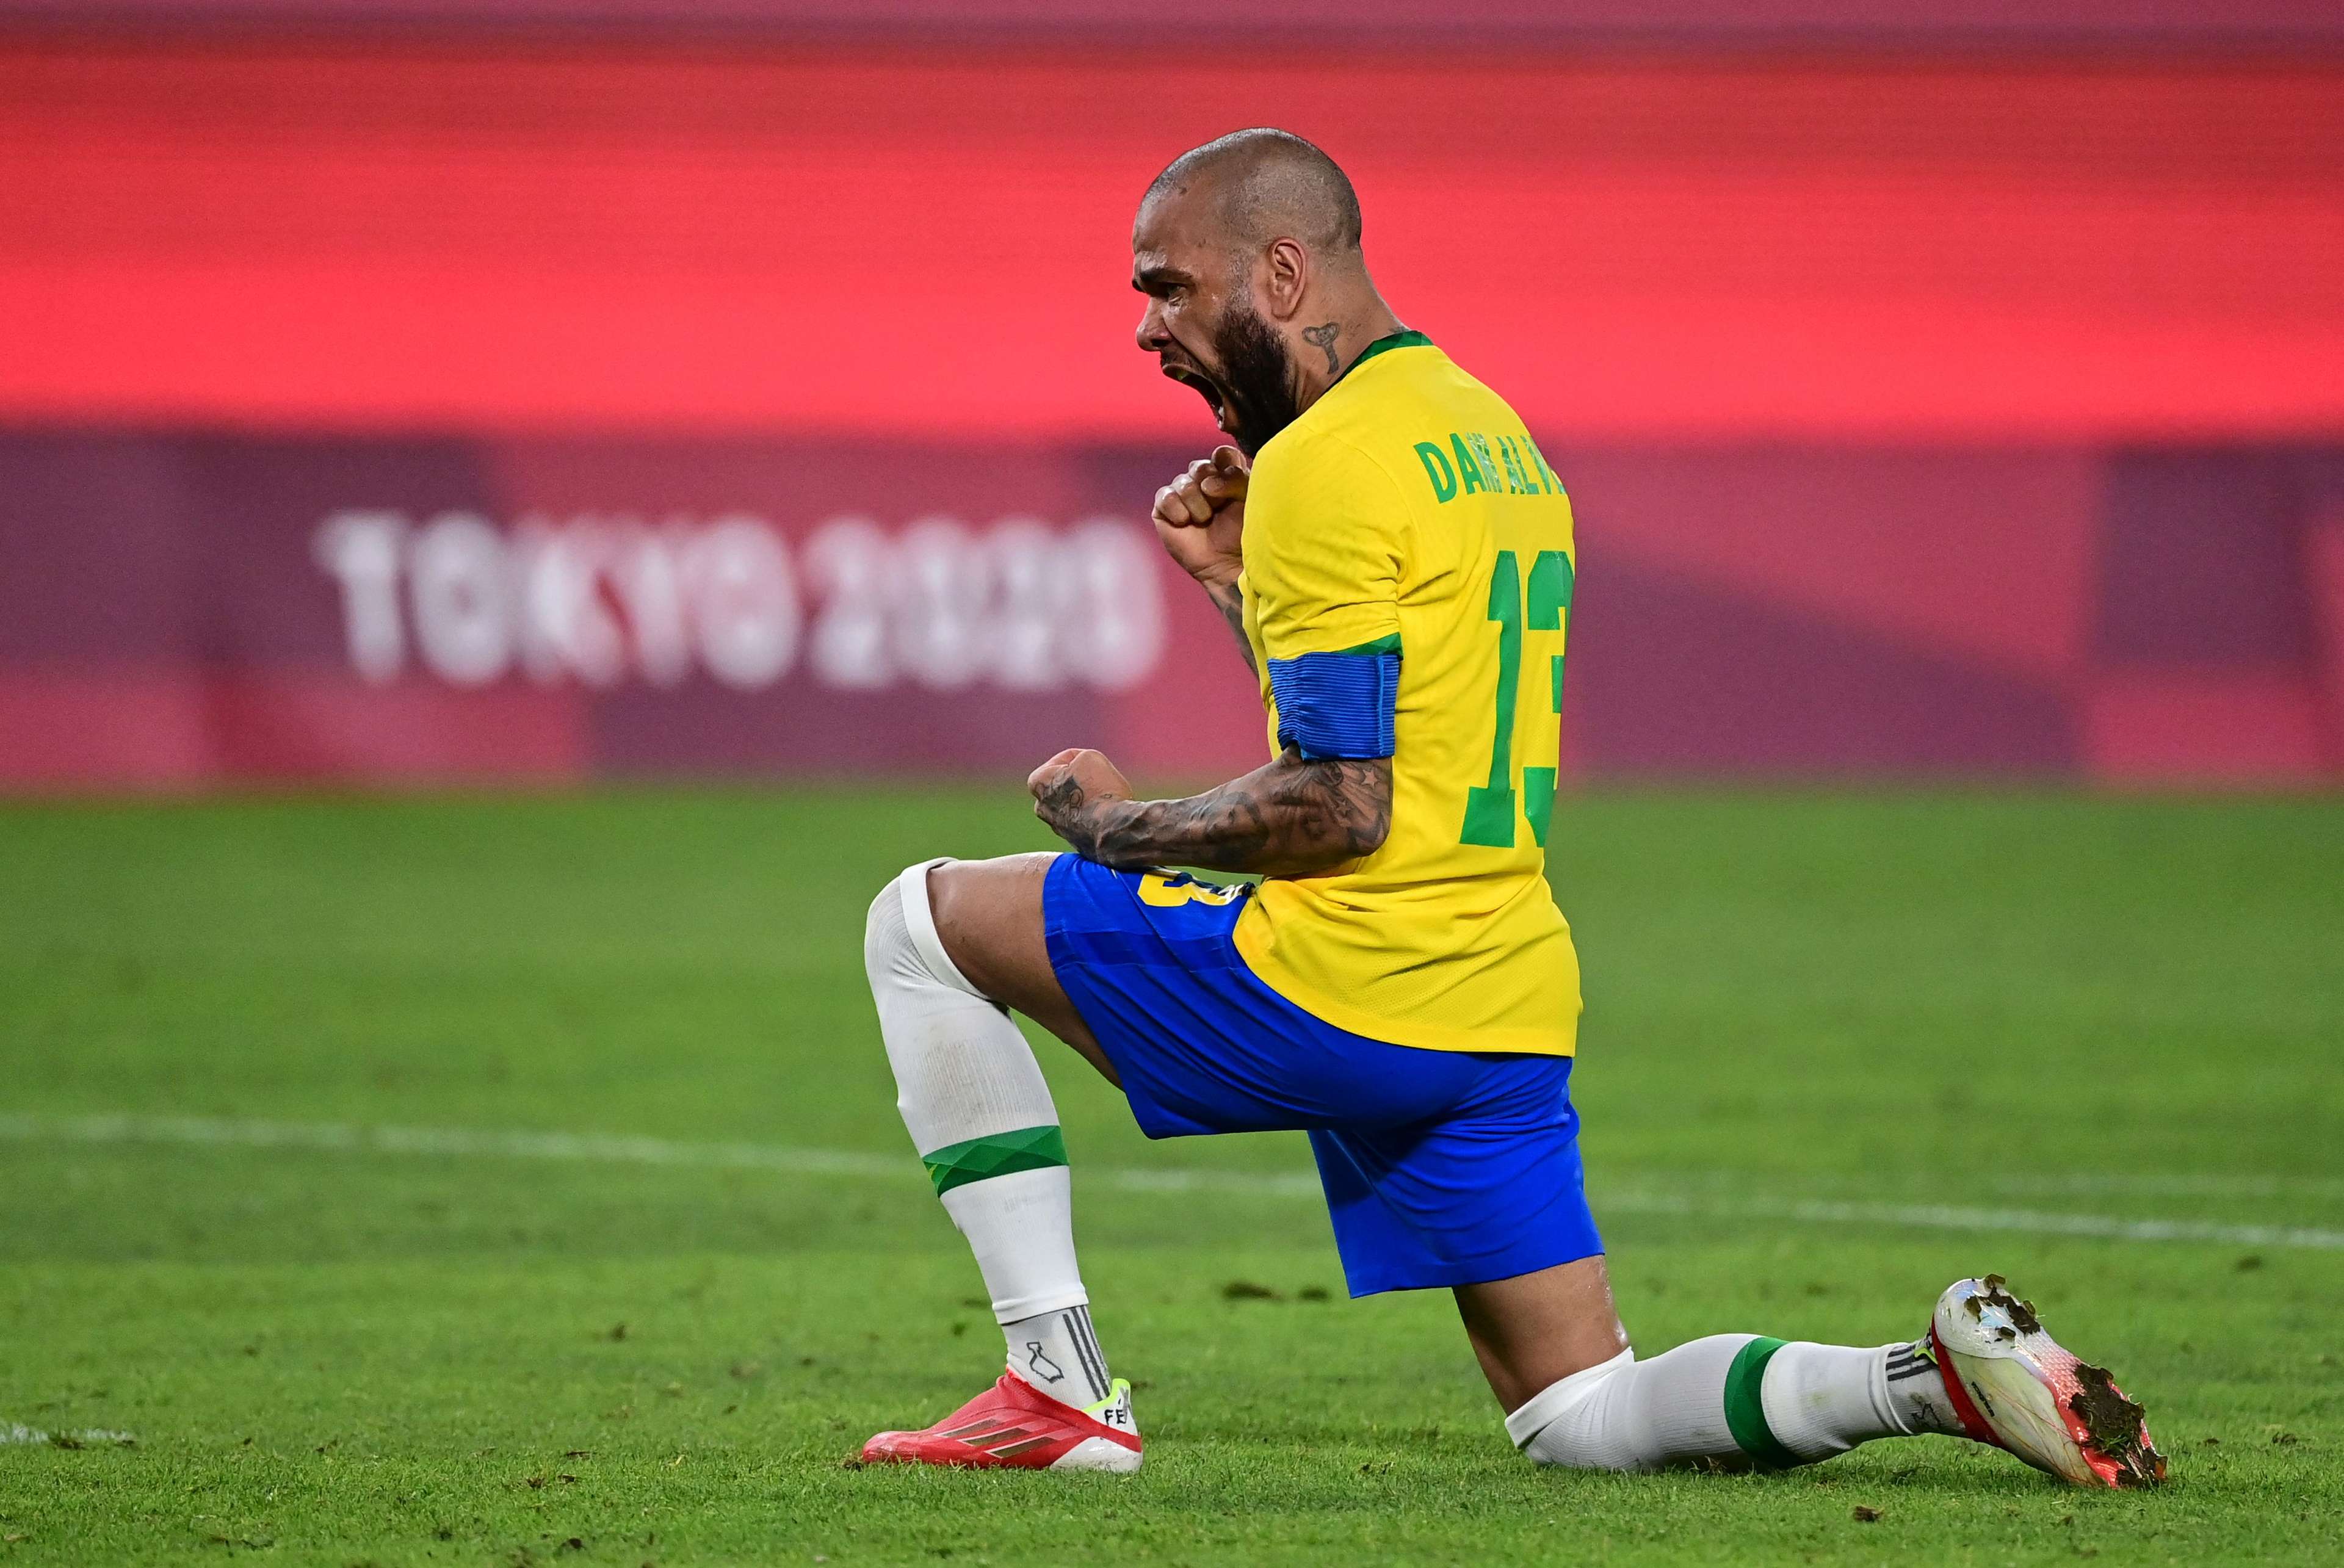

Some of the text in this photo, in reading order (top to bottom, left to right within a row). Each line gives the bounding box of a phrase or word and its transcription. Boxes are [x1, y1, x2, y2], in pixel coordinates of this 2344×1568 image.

[319, 511, 1165, 690] TOKYO 2020
[1459, 550, 1575, 848] 13
